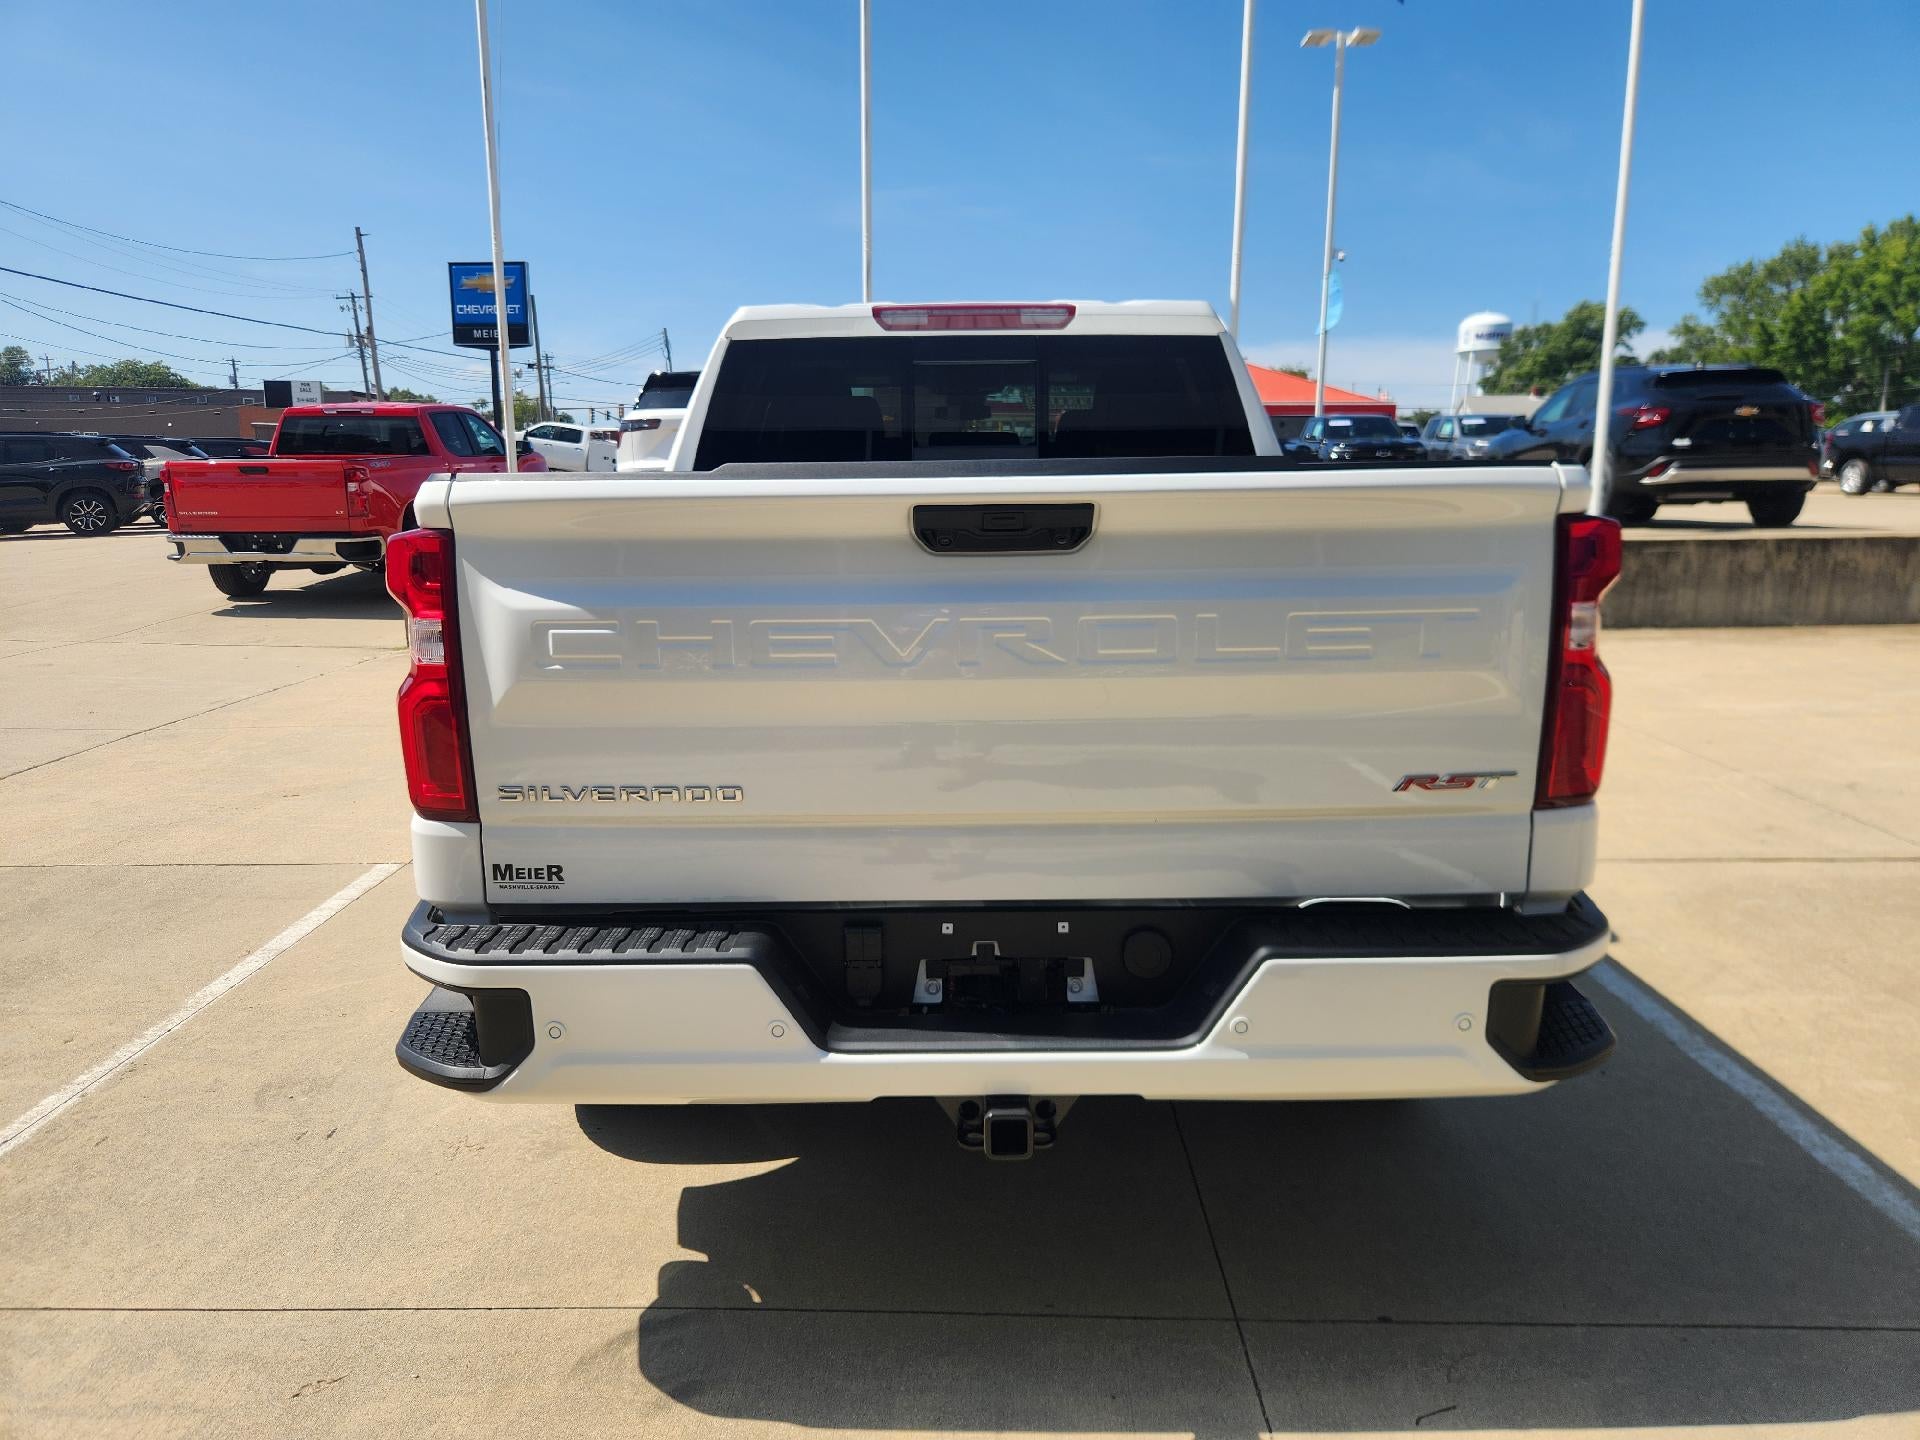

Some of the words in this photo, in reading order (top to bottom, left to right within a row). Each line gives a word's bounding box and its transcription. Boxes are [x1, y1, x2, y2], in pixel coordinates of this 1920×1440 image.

[456, 304, 520, 315] CHEVRET
[473, 329, 502, 338] MEIE
[530, 608, 1480, 670] CHEVROLET
[1392, 770, 1518, 792] RST
[497, 784, 744, 803] SILVERADO
